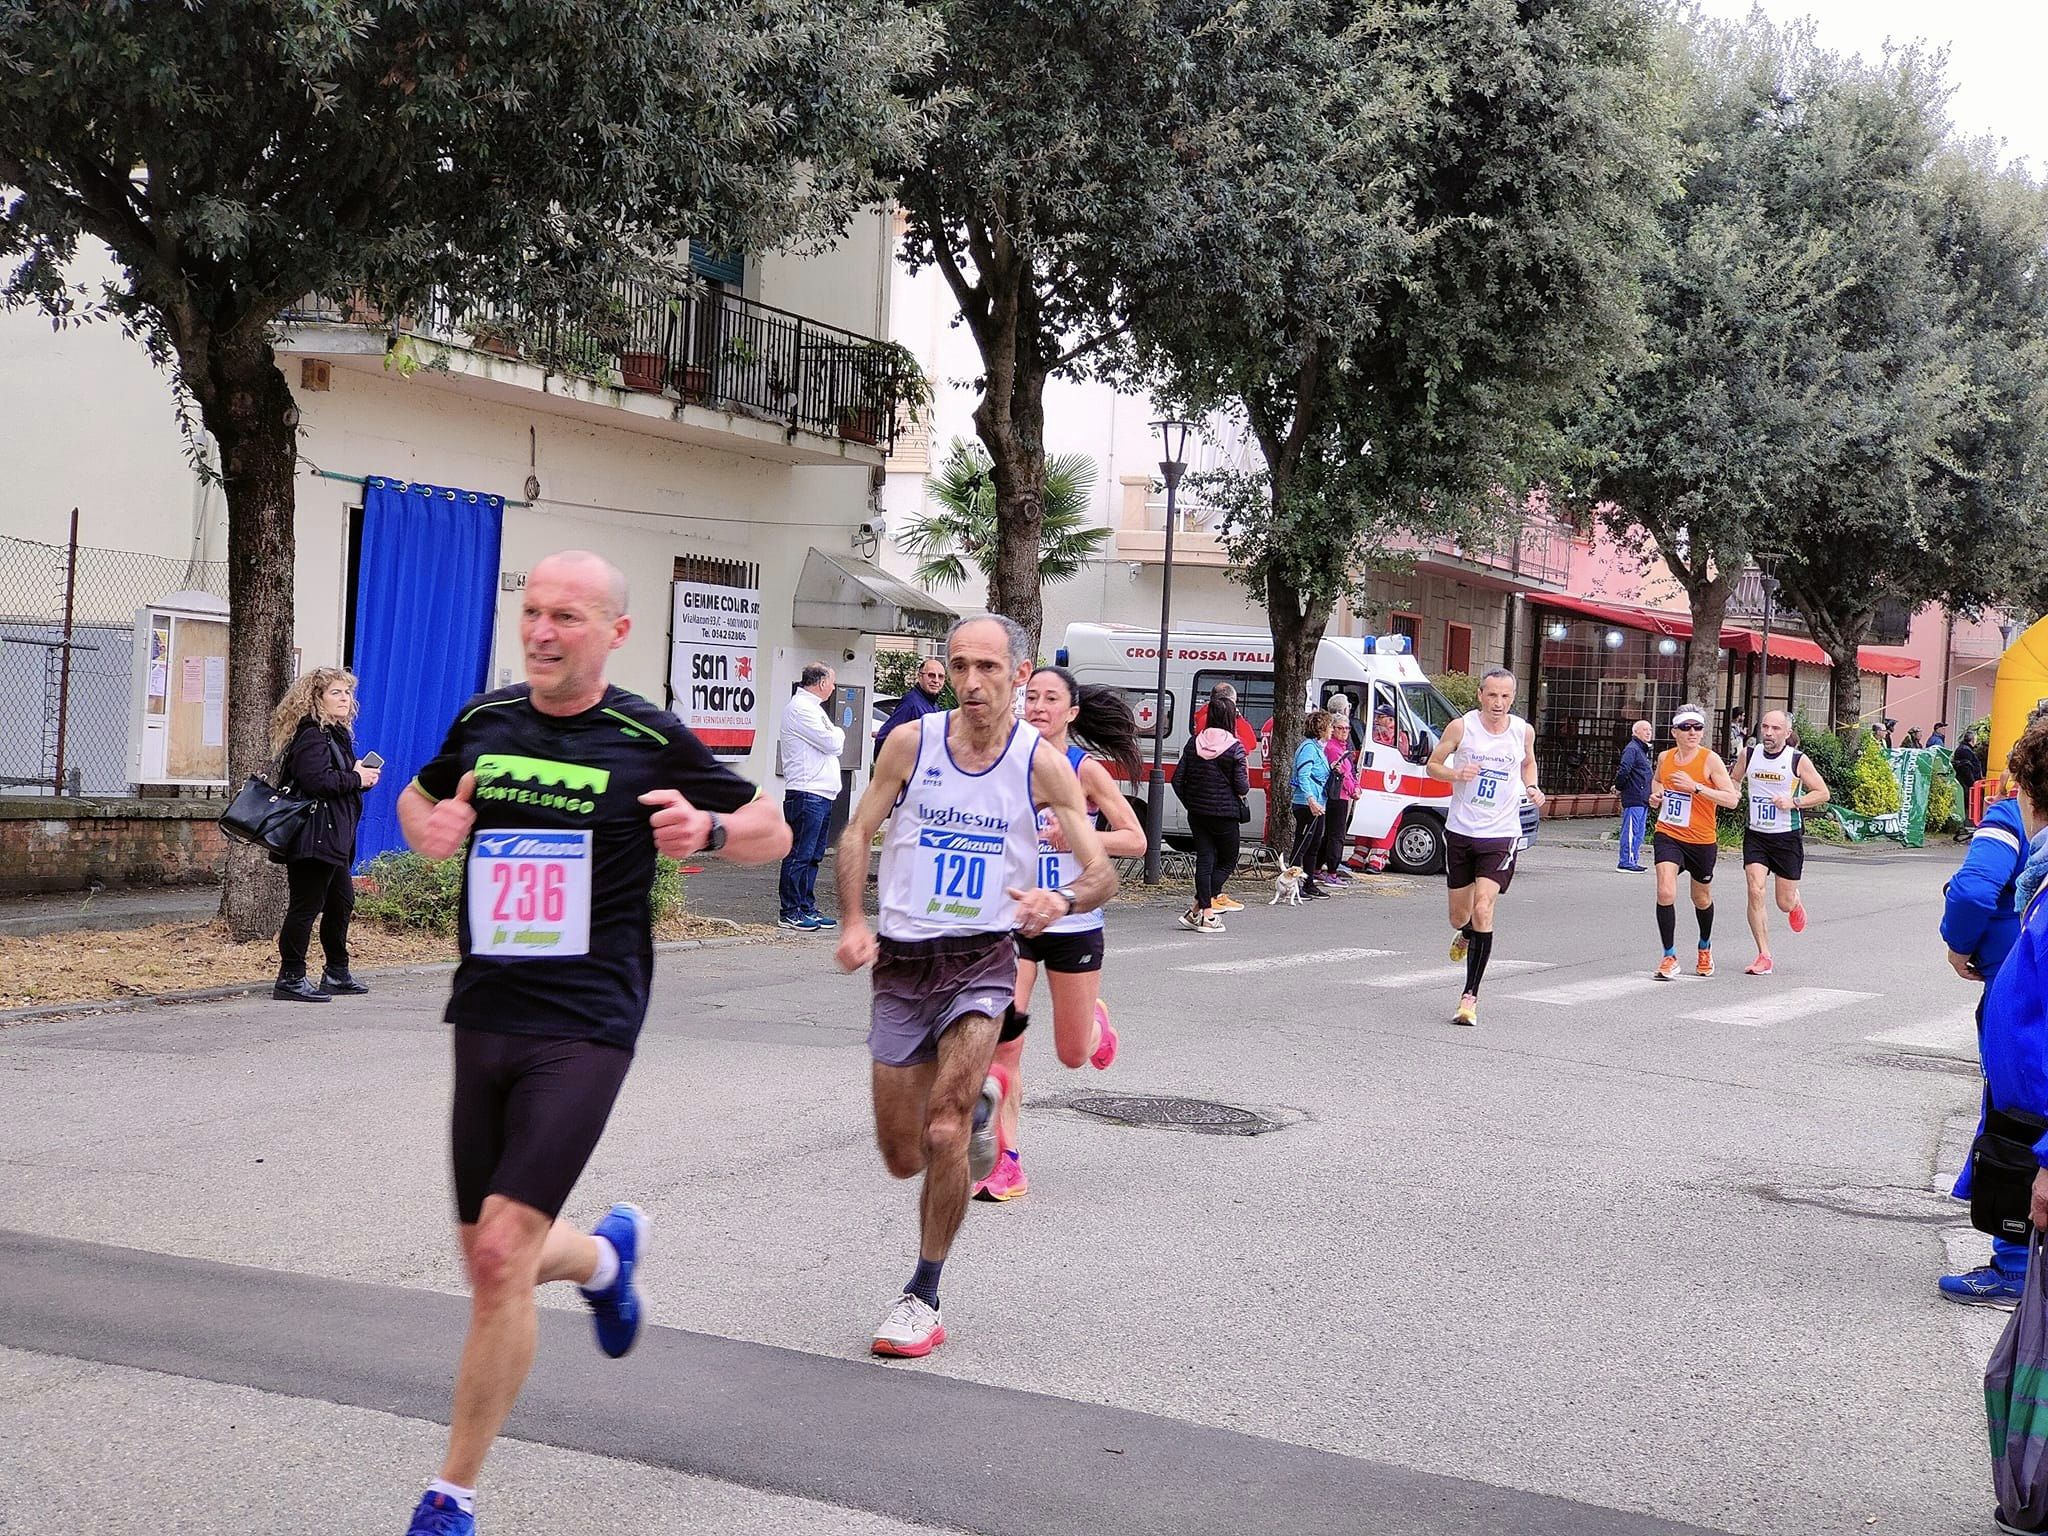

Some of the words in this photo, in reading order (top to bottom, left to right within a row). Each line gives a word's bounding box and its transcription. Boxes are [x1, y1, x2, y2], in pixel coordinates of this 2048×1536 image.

[692, 653, 728, 681] san
[1178, 649, 1227, 662] ROSSA
[692, 684, 755, 713] marco
[1477, 778, 1497, 799] 63
[919, 803, 1009, 833] lughesina
[1668, 799, 1682, 817] 59
[1757, 804, 1777, 820] 150
[934, 853, 986, 900] 120
[492, 864, 566, 922] 236
